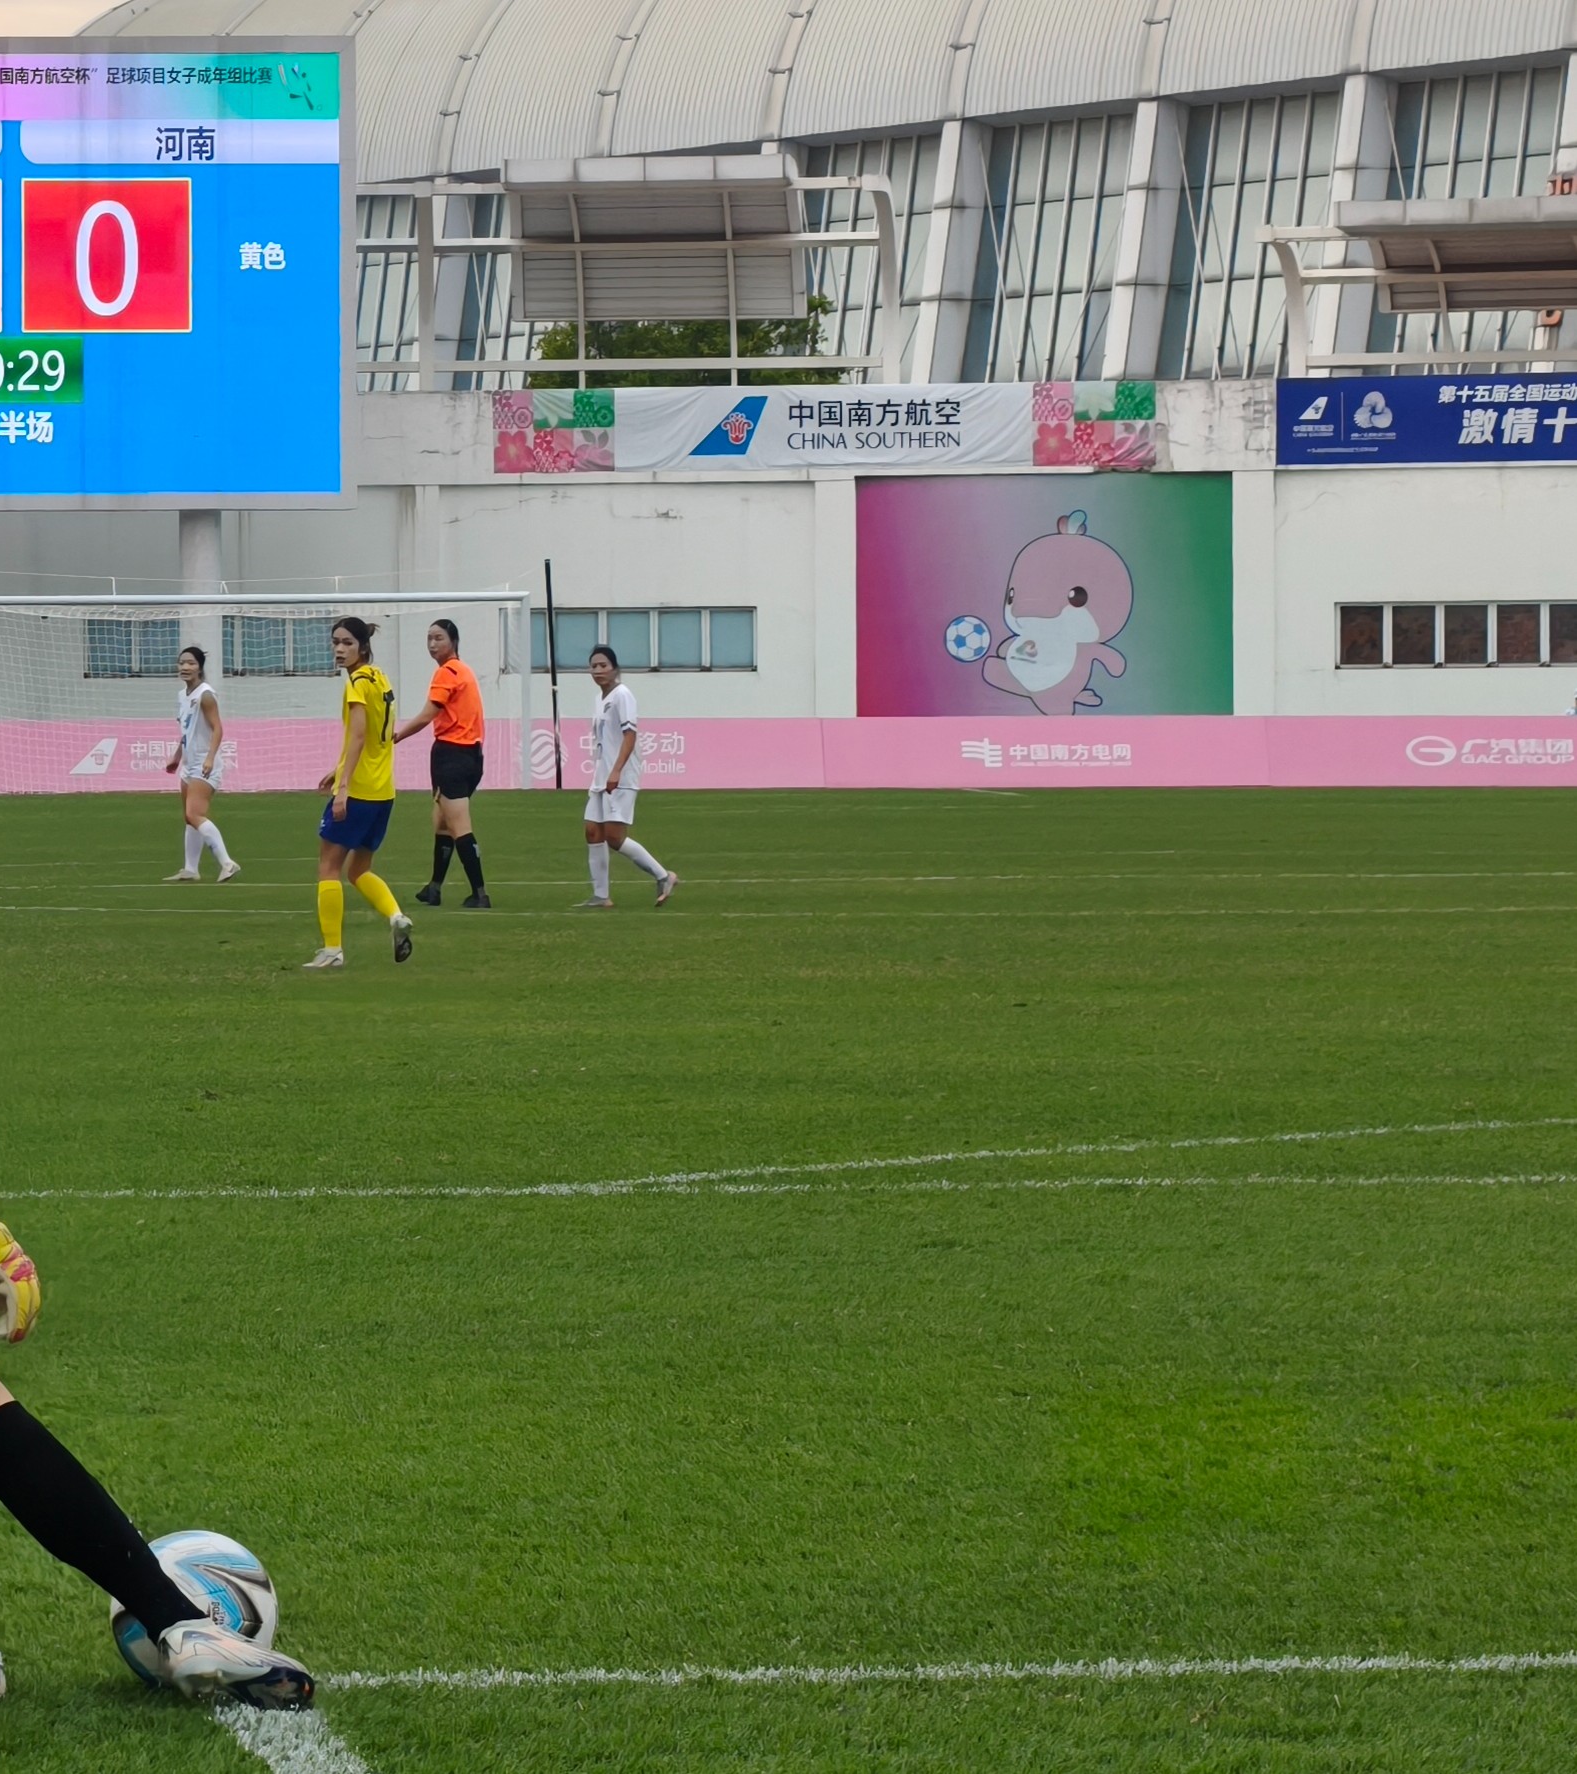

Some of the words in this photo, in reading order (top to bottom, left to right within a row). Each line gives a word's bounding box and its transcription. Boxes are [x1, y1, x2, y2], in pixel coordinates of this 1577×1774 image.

[155, 126, 216, 162] 河南
[75, 200, 139, 317] 0
[238, 241, 287, 272] 黄色
[788, 397, 962, 429] 中国南方航空
[1457, 405, 1577, 445] 激情十
[787, 431, 848, 450] CHINA
[854, 430, 961, 450] SOUTHERN
[578, 731, 685, 756] 中移动
[1009, 743, 1132, 761] 中国南方电网
[1460, 754, 1503, 764] GAC
[1505, 754, 1575, 764] GROUP
